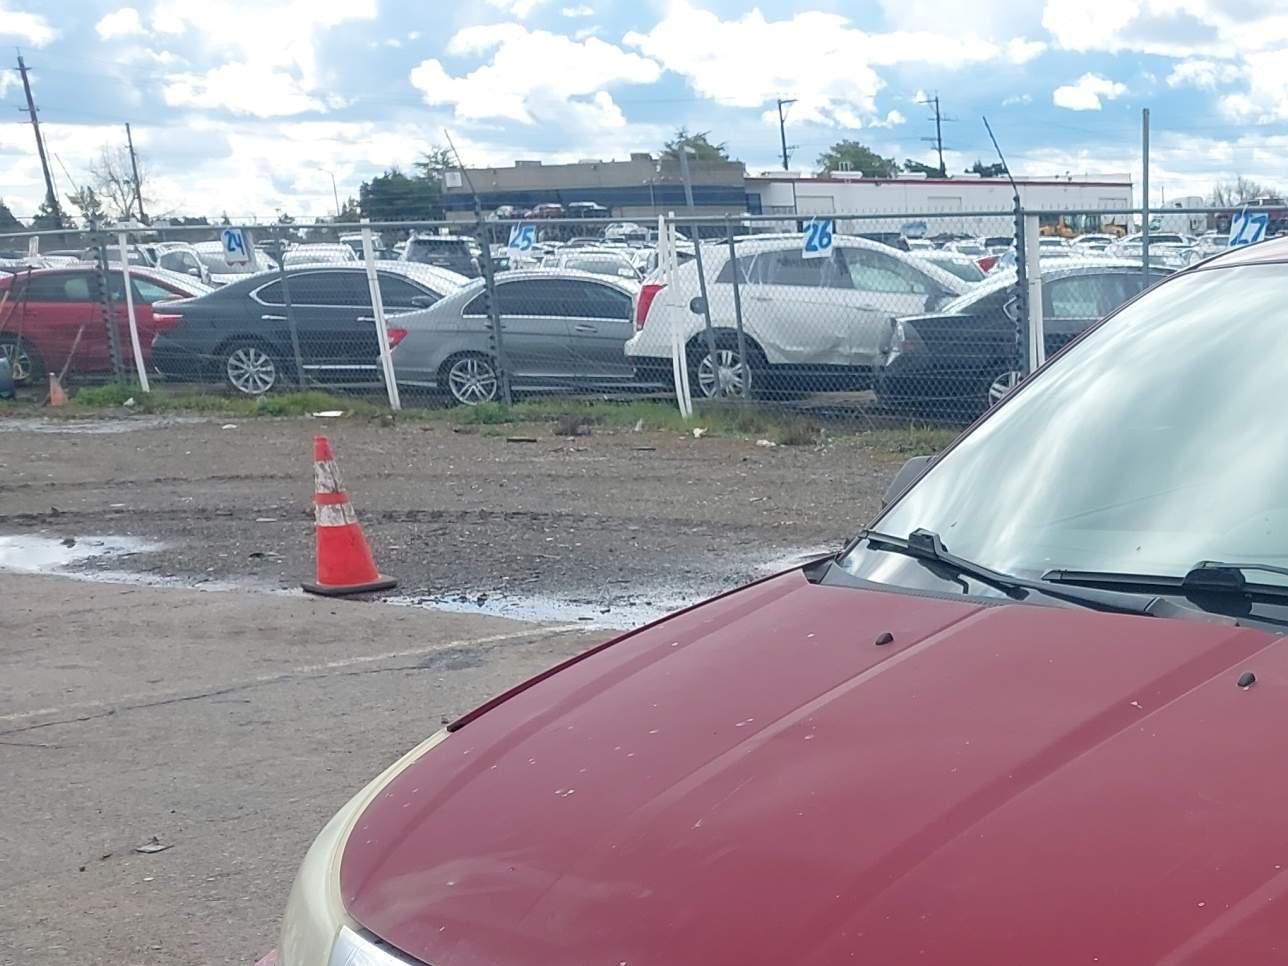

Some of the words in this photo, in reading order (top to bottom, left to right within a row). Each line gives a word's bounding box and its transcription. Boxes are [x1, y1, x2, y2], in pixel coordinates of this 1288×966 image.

[224, 230, 245, 256] 24
[510, 224, 533, 251] 25
[803, 218, 832, 251] 26
[1230, 209, 1267, 247] 27
